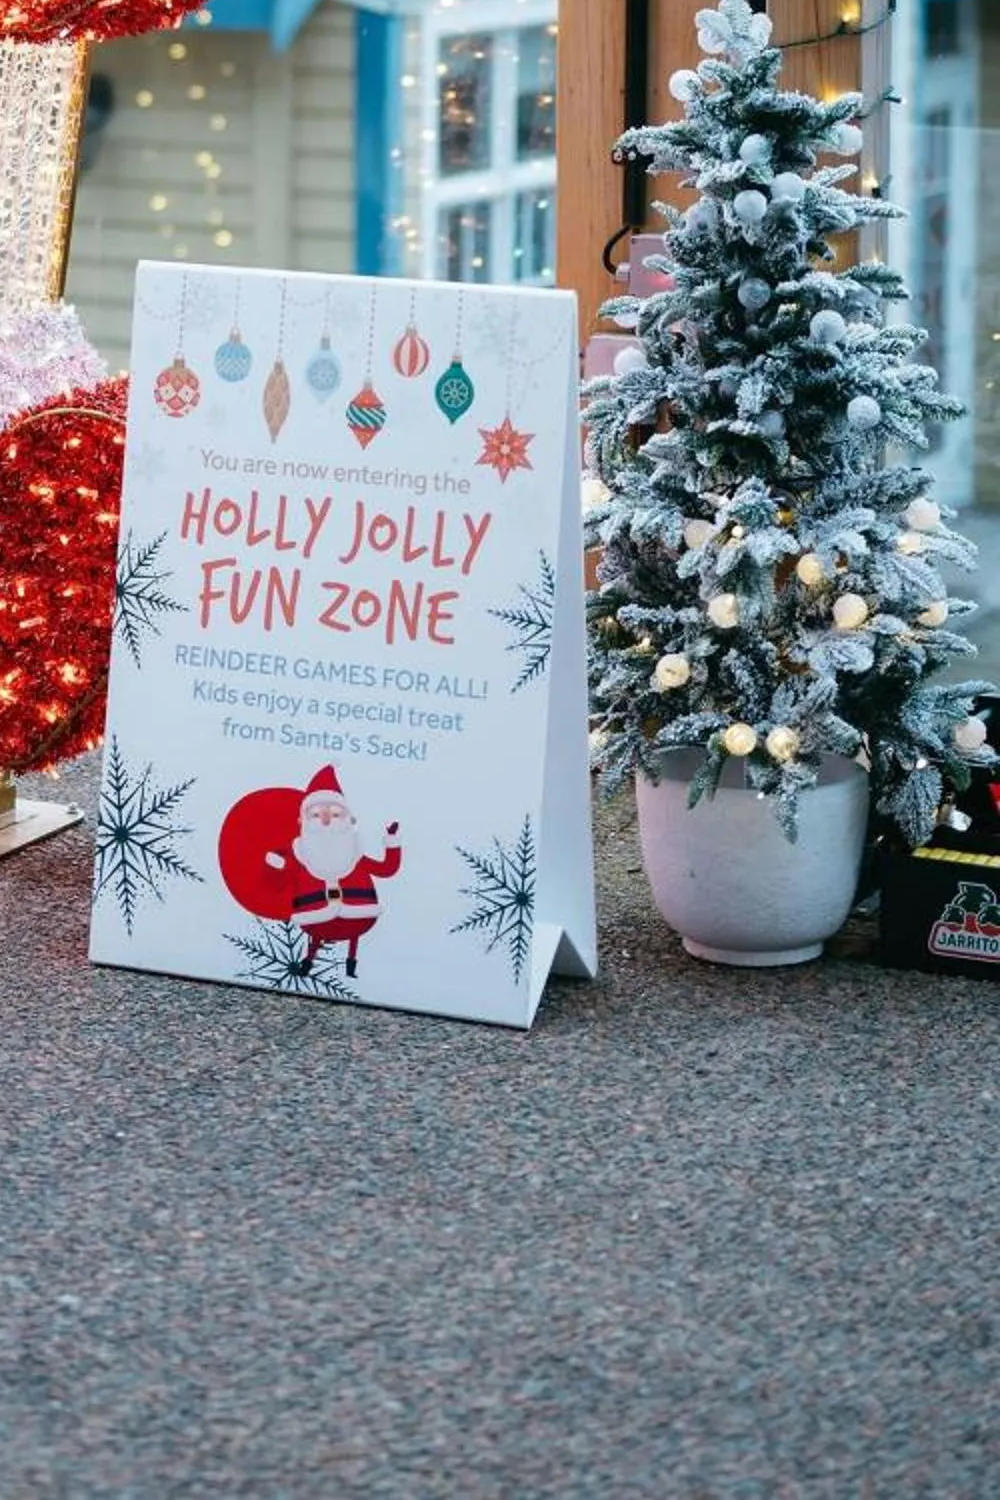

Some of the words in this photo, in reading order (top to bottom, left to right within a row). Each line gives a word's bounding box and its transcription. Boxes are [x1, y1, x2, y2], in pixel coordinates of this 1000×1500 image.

[200, 449, 239, 472] You
[243, 456, 278, 474] are
[282, 460, 329, 480] now
[333, 465, 428, 495] entering
[433, 472, 472, 494] the
[180, 487, 333, 559] HOLLY
[339, 501, 492, 576] JOLLY
[199, 558, 301, 632] FUN
[318, 579, 460, 646] ZONE
[175, 644, 287, 676] REINDEER
[293, 658, 376, 687] GAMES
[383, 669, 431, 693] FOR
[435, 675, 489, 700] ALL!
[192, 679, 238, 705] Kids
[243, 688, 303, 717] enjoy
[307, 699, 320, 714] a
[326, 699, 403, 725] special
[408, 708, 464, 732] treat
[222, 717, 275, 742] from
[280, 724, 361, 754] Santa's
[366, 735, 428, 761] Sack!
